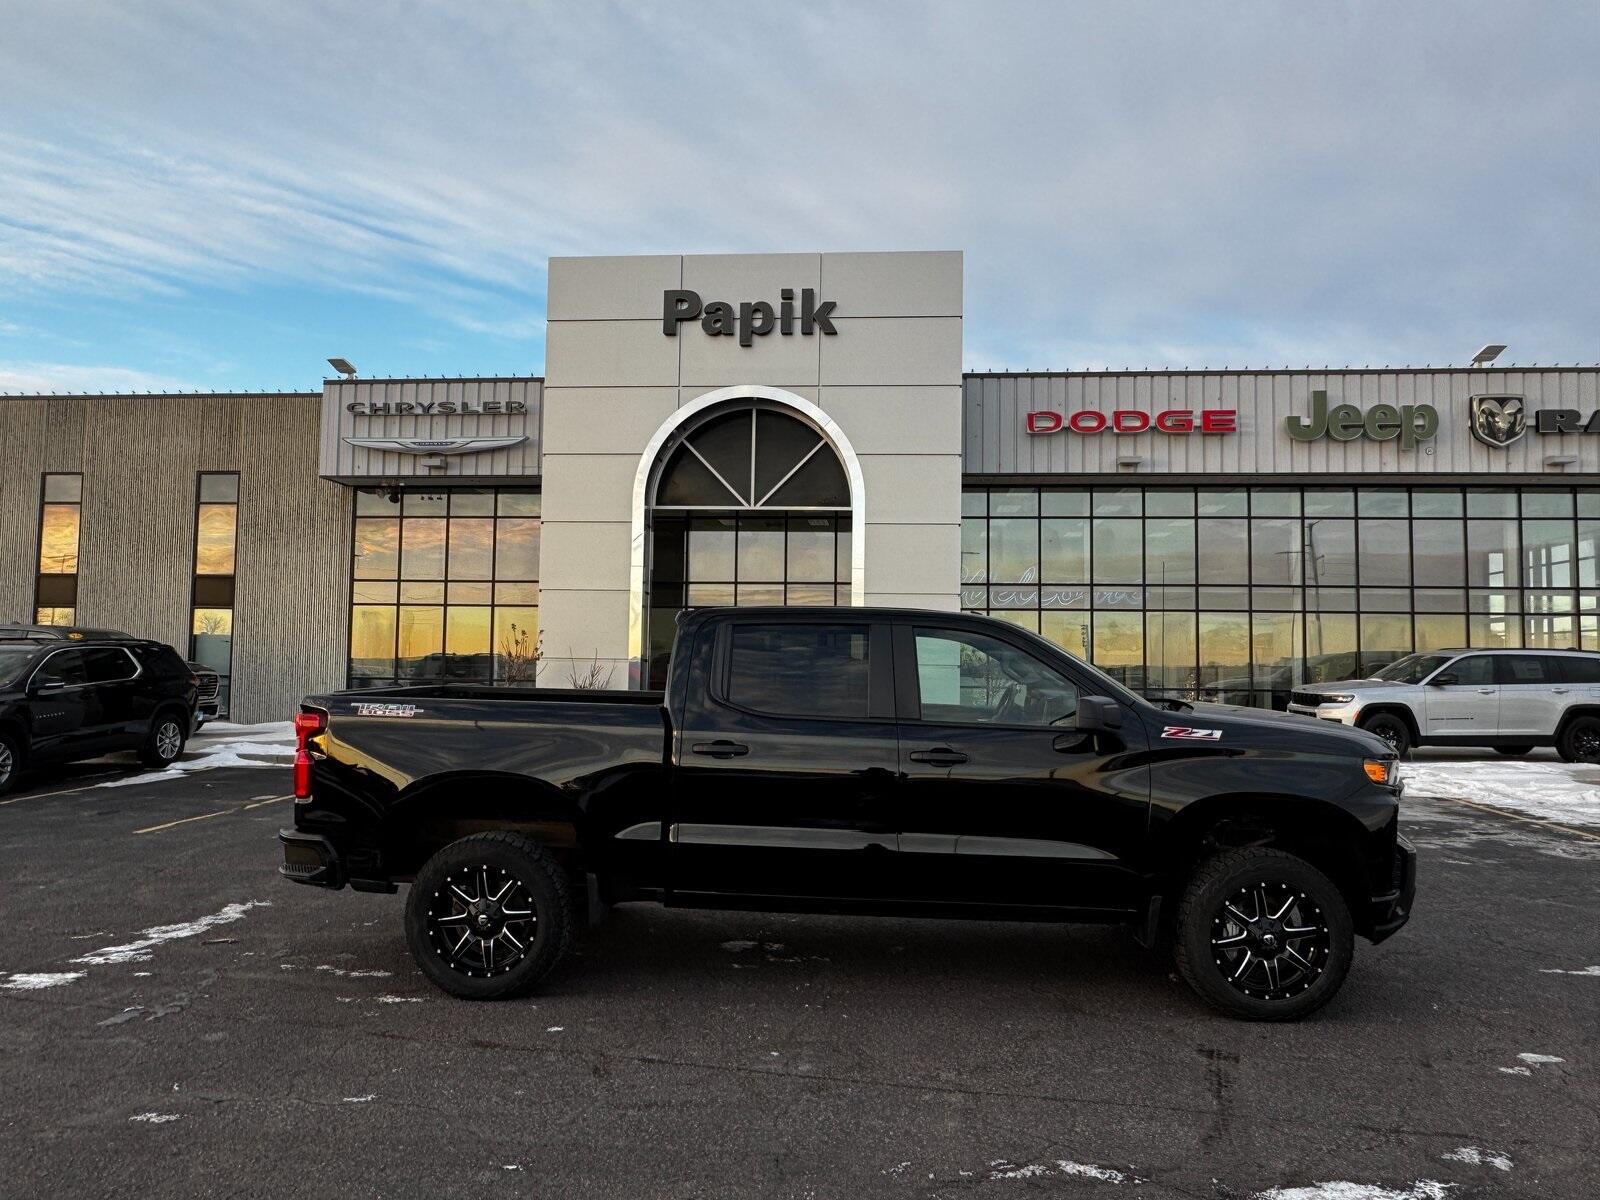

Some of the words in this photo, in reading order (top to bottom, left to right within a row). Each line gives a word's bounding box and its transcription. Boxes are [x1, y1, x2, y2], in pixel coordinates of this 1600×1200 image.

[663, 288, 838, 347] Papik
[346, 401, 527, 415] CHRYSLER
[1286, 390, 1439, 450] Jeep
[1026, 409, 1237, 433] DODGE
[1161, 726, 1223, 741] Z71
